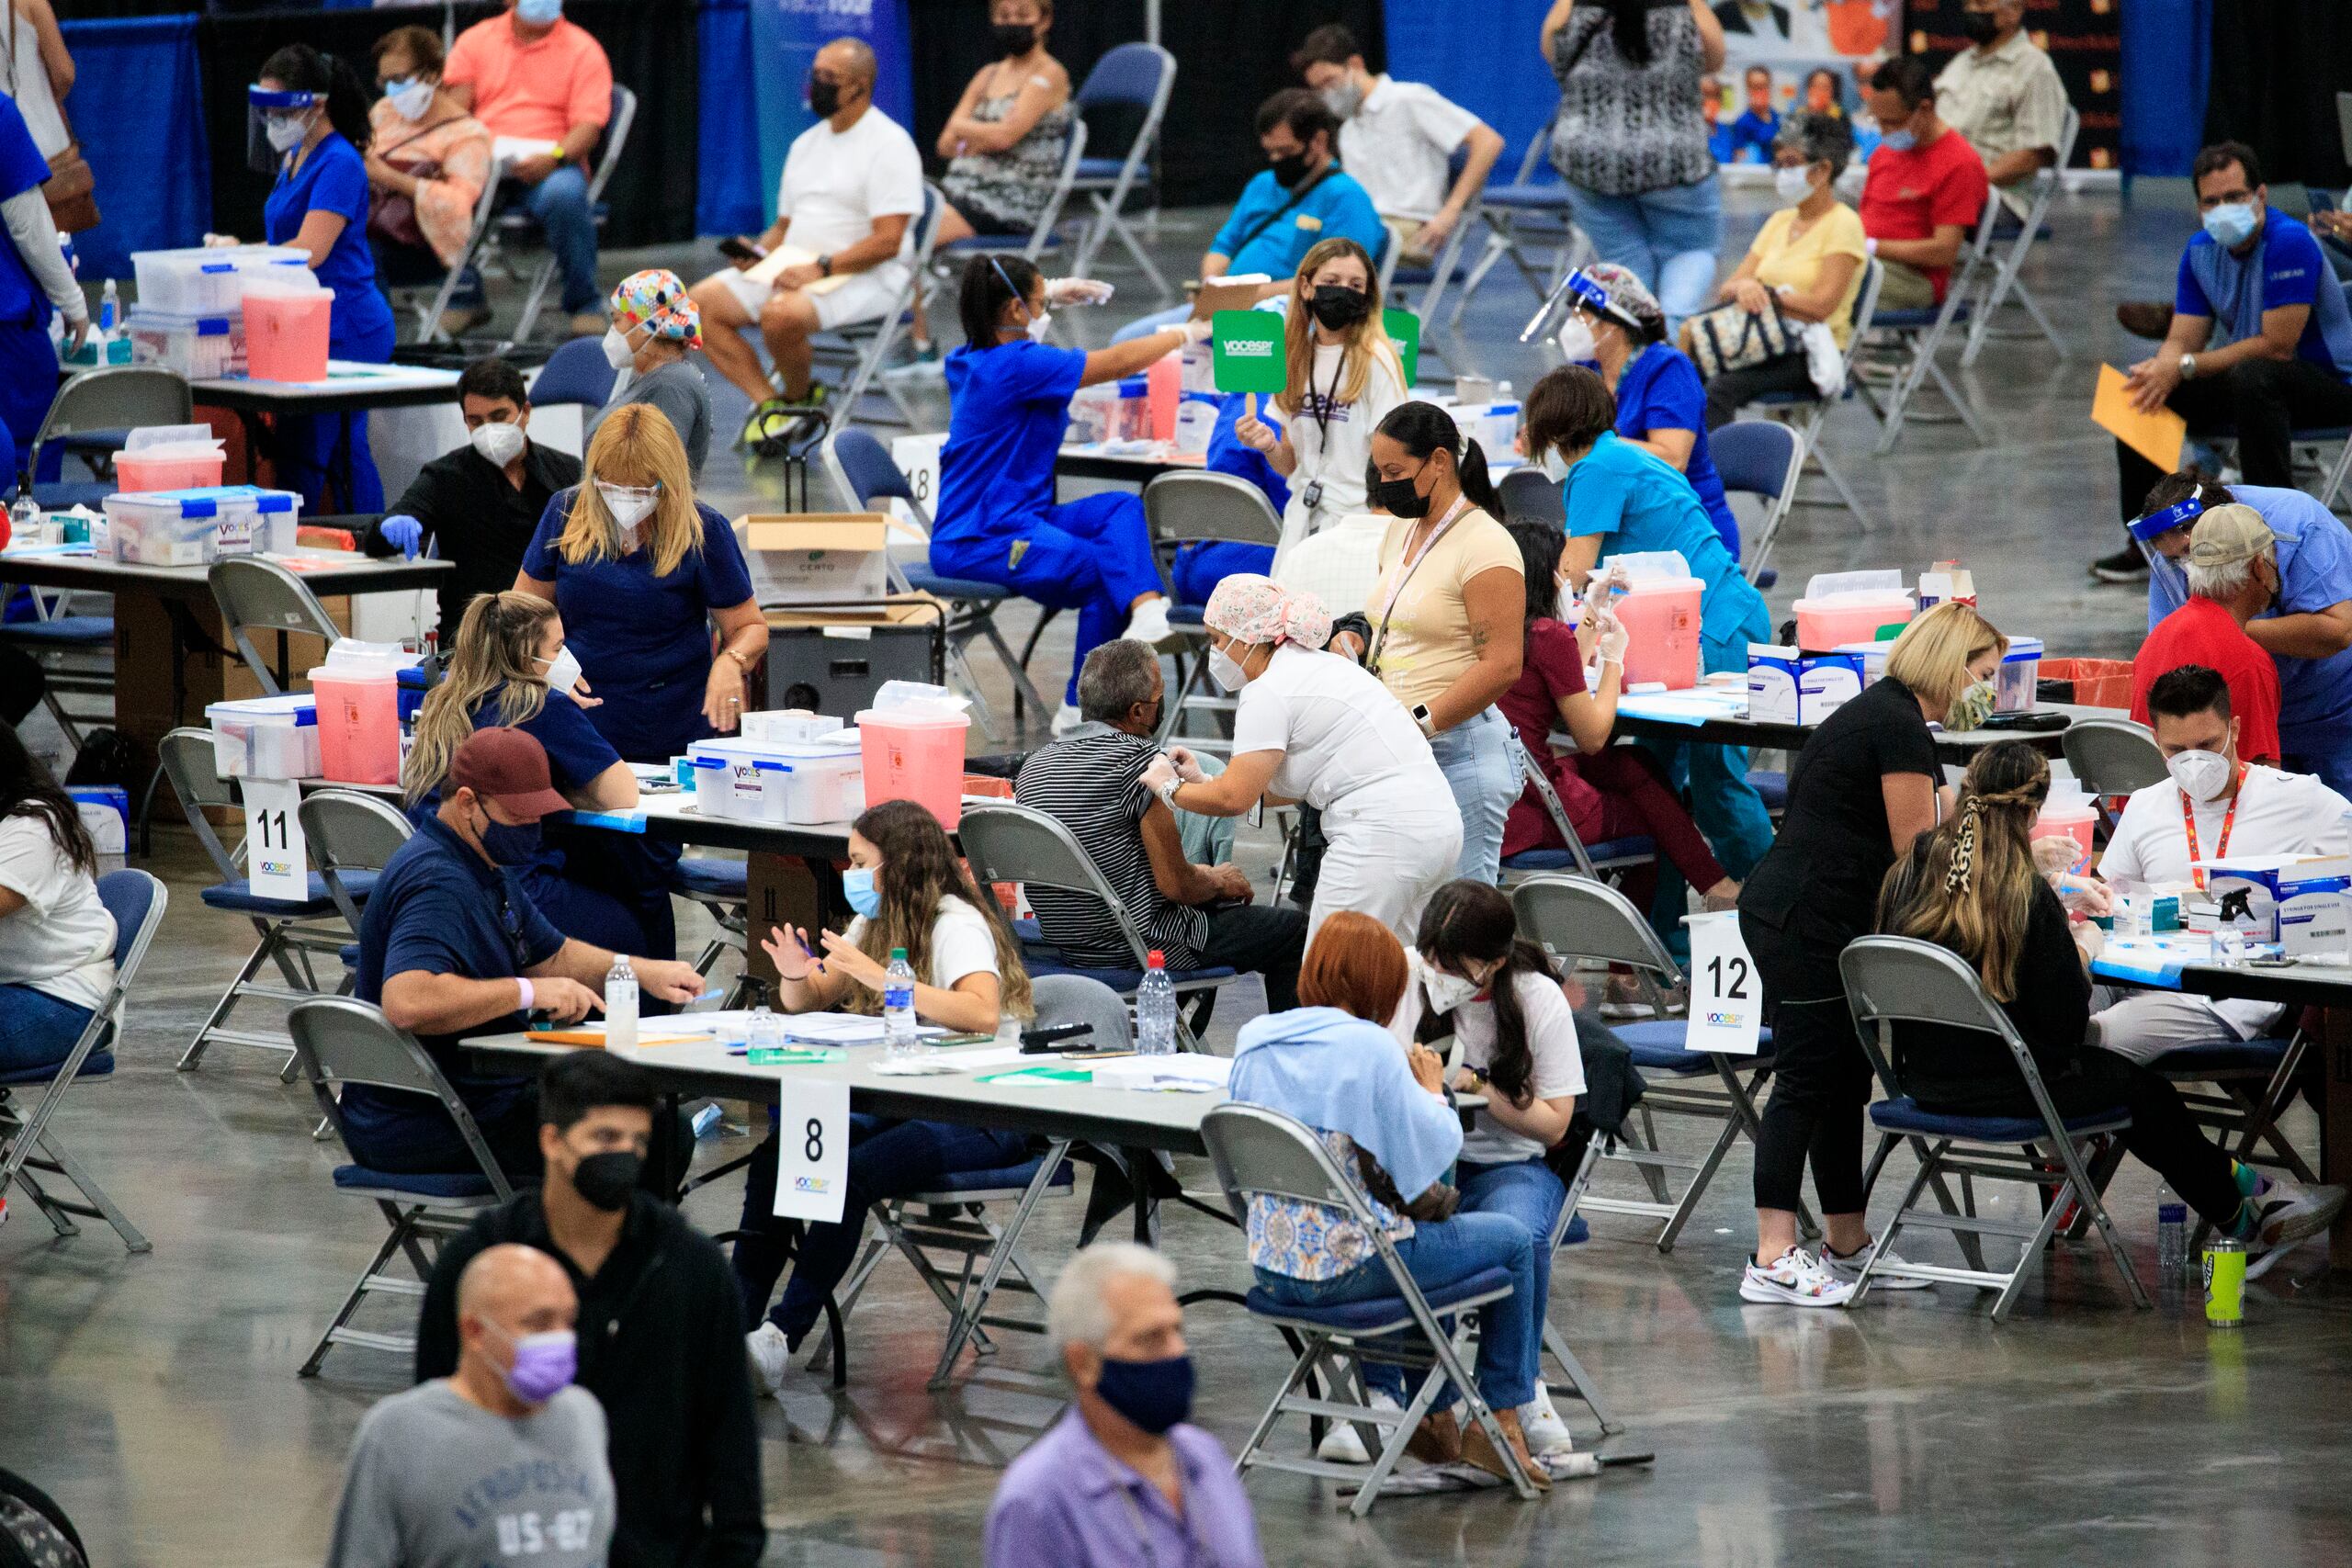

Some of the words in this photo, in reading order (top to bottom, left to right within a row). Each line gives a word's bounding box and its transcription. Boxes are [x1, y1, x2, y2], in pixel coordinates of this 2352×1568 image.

[257, 808, 288, 850] 11
[1707, 955, 1747, 999] 12
[805, 1117, 823, 1163] 8
